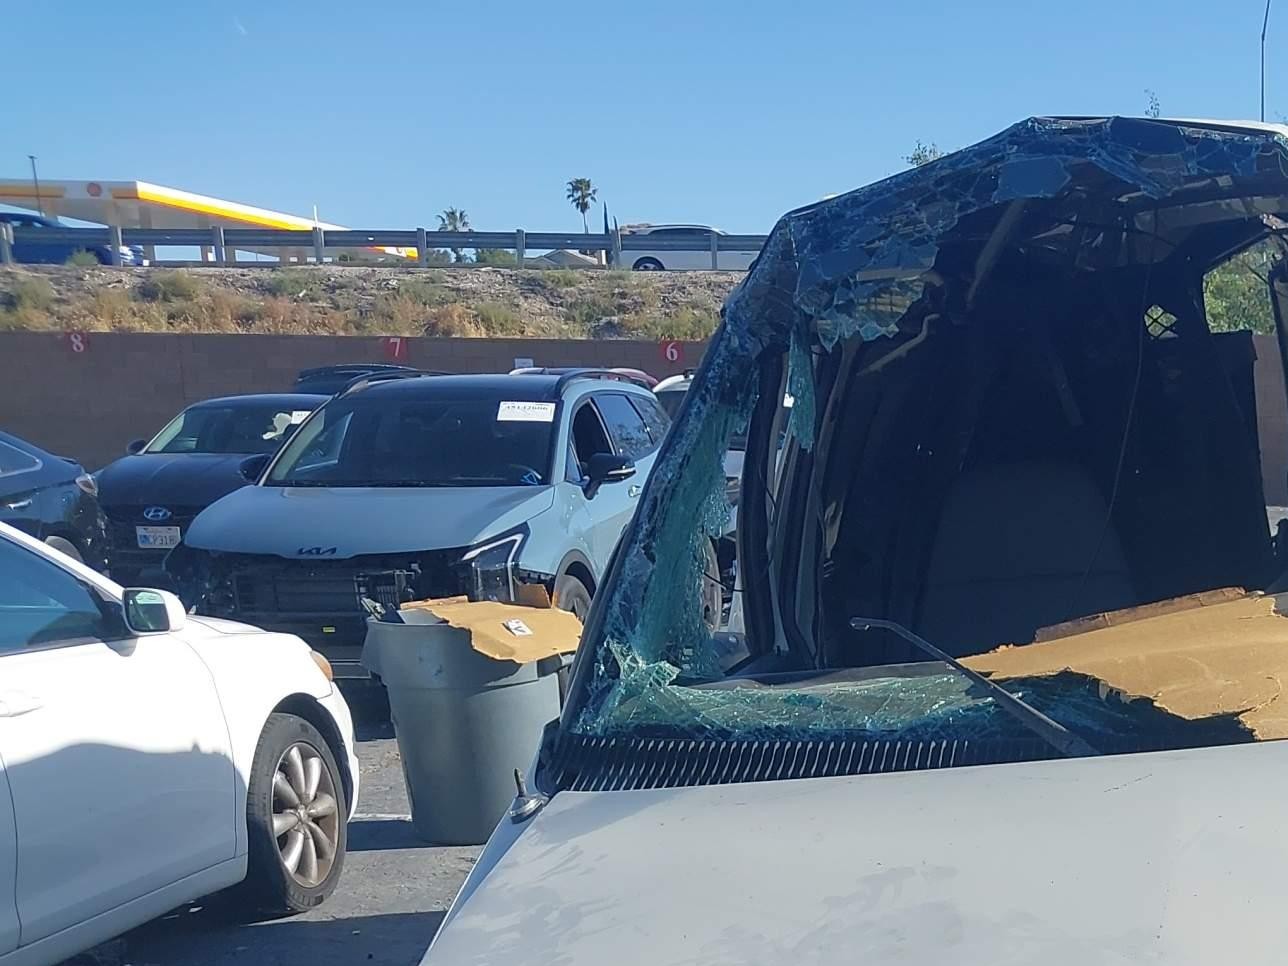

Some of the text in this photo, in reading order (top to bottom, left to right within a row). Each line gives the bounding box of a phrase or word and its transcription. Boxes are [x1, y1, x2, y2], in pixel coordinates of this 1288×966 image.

[70, 333, 84, 353] 8
[389, 337, 401, 358] 7
[666, 342, 678, 361] 6
